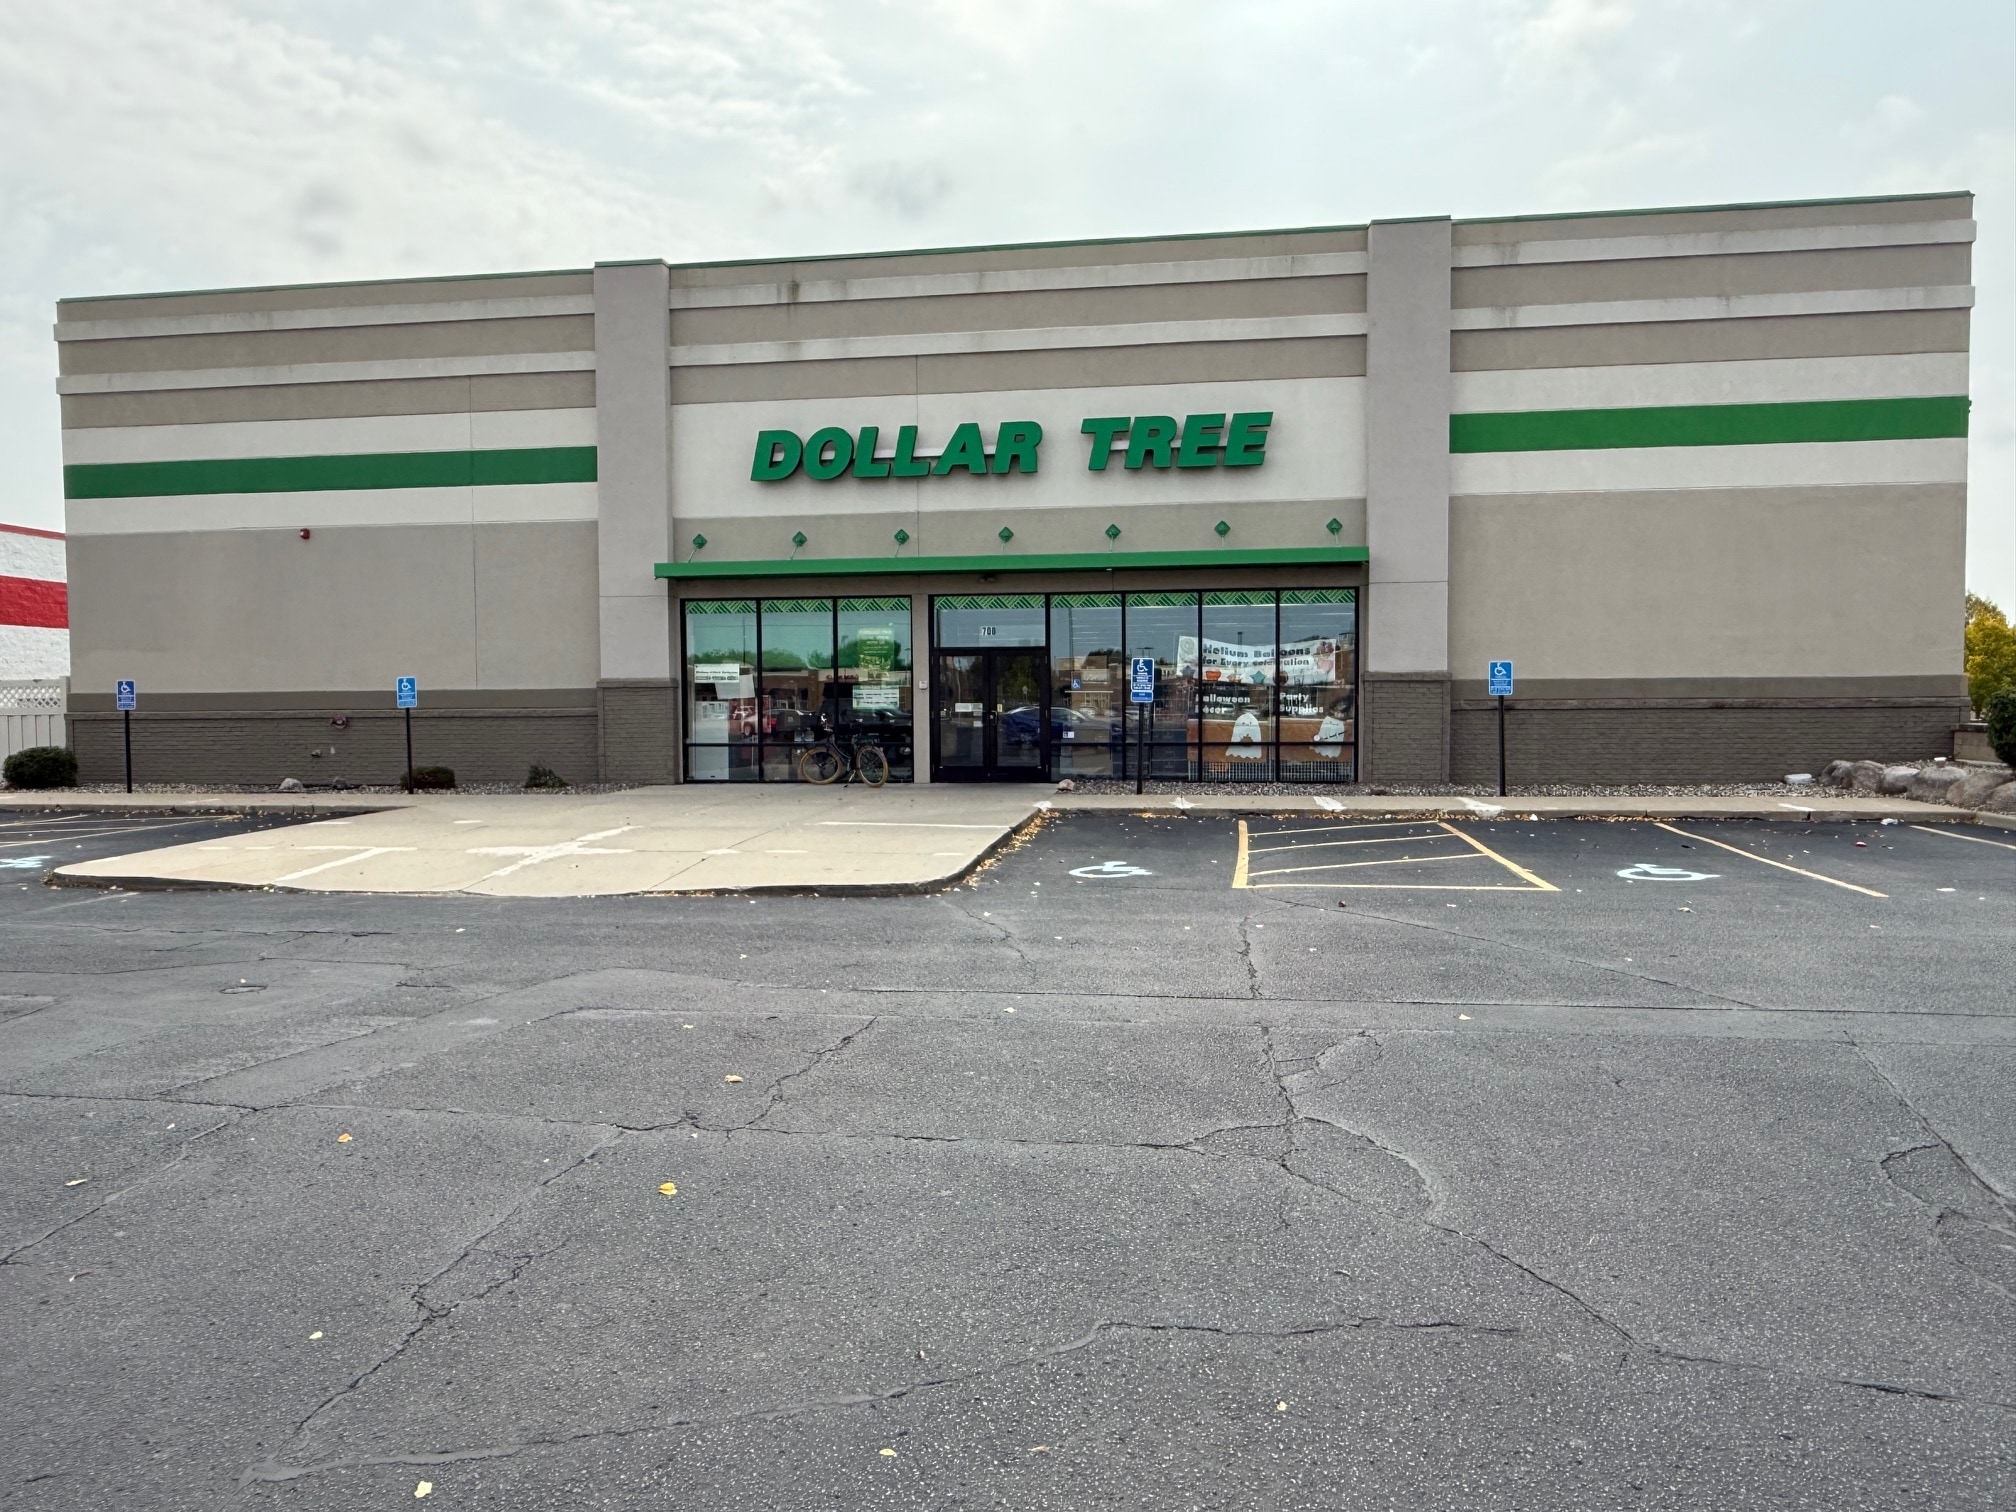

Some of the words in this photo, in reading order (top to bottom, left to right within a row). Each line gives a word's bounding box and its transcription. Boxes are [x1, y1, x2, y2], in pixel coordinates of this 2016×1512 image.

[750, 421, 1043, 482] DOLLAR
[1081, 411, 1274, 471] TREE
[982, 626, 996, 636] 700
[1203, 644, 1248, 657] Helium
[1254, 647, 1311, 658] Baloons
[1202, 656, 1217, 665] for
[1221, 657, 1249, 667] Every
[1280, 692, 1309, 702] Party
[1280, 705, 1324, 715] Supplies
